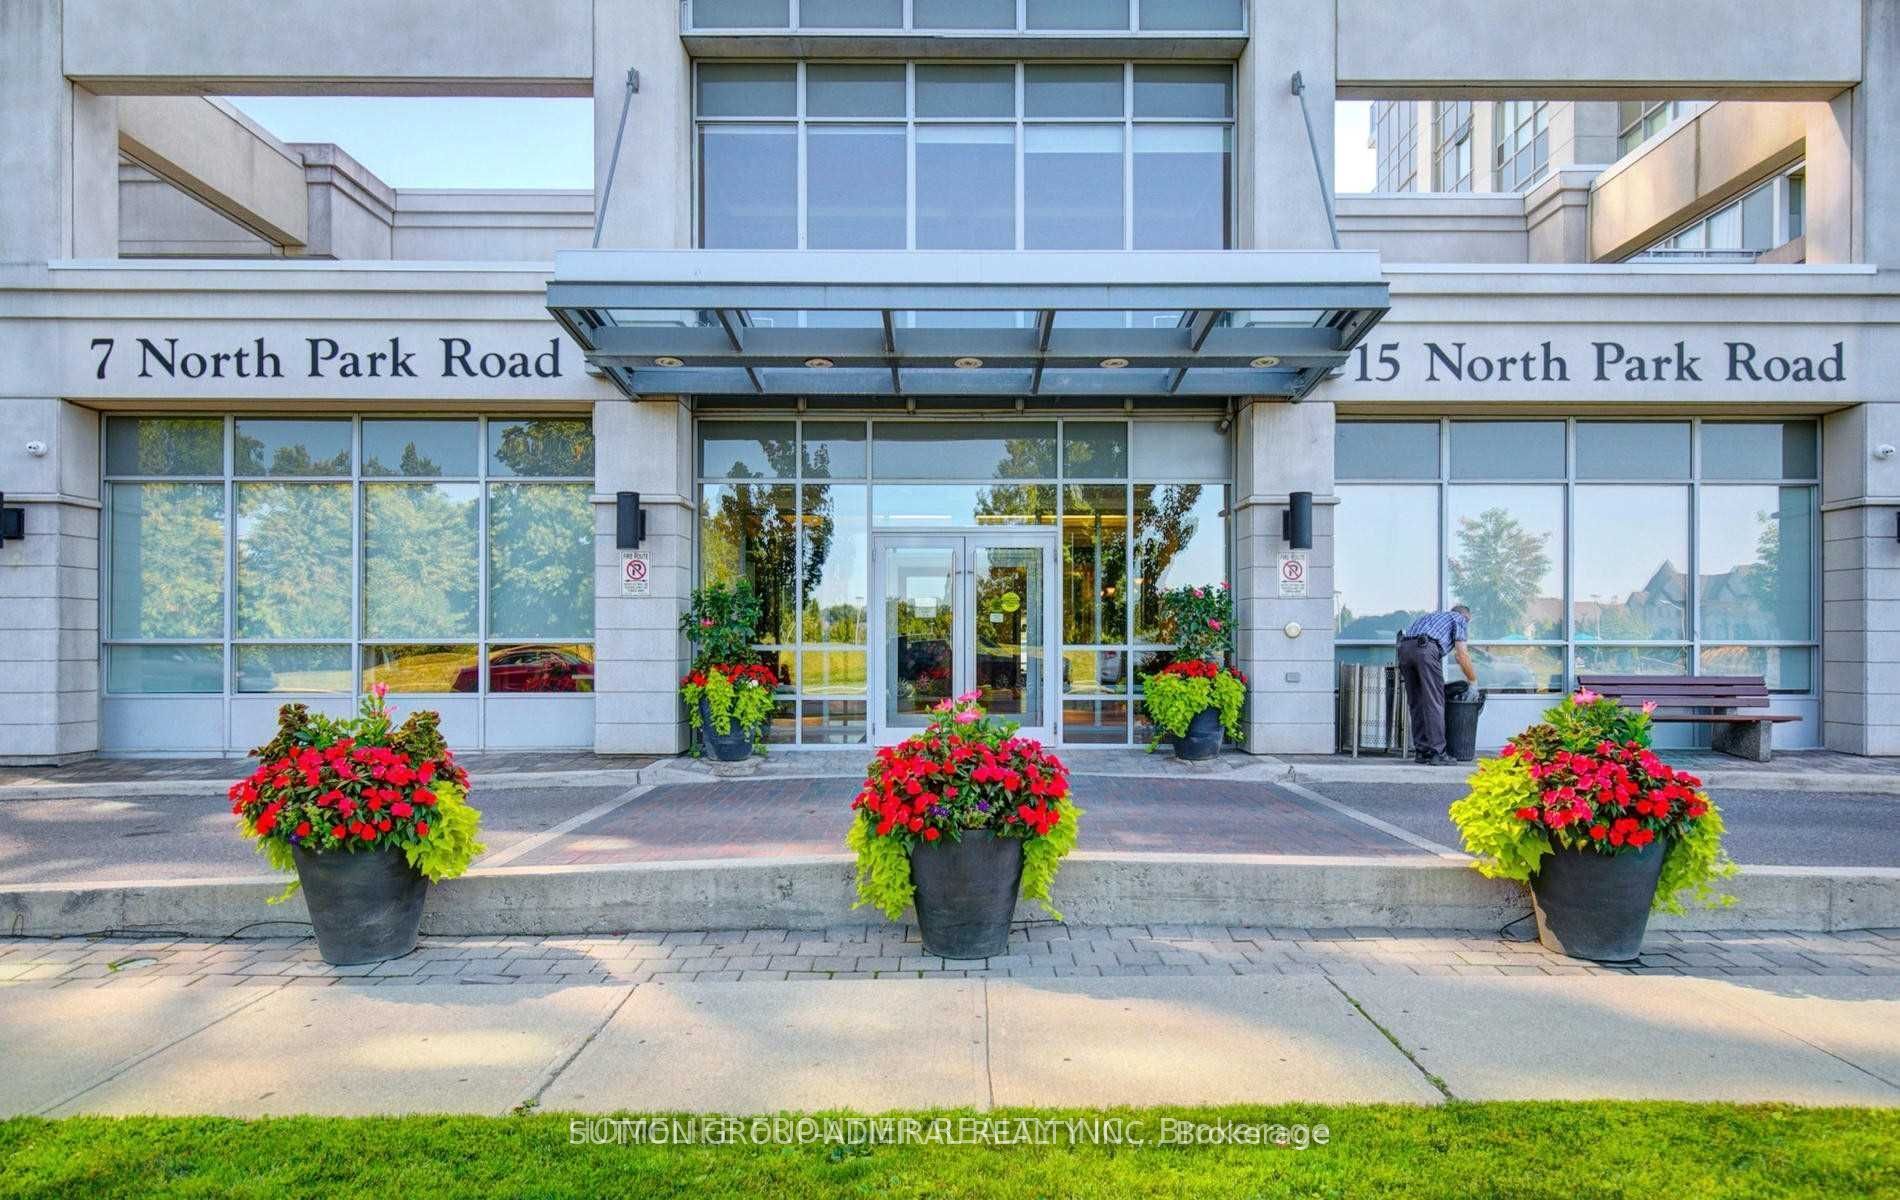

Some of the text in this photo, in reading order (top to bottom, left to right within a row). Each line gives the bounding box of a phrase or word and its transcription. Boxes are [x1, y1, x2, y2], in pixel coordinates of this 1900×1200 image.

[90, 336, 563, 380] 7 North Park Road
[1355, 340, 1846, 383] 15 North Park Road
